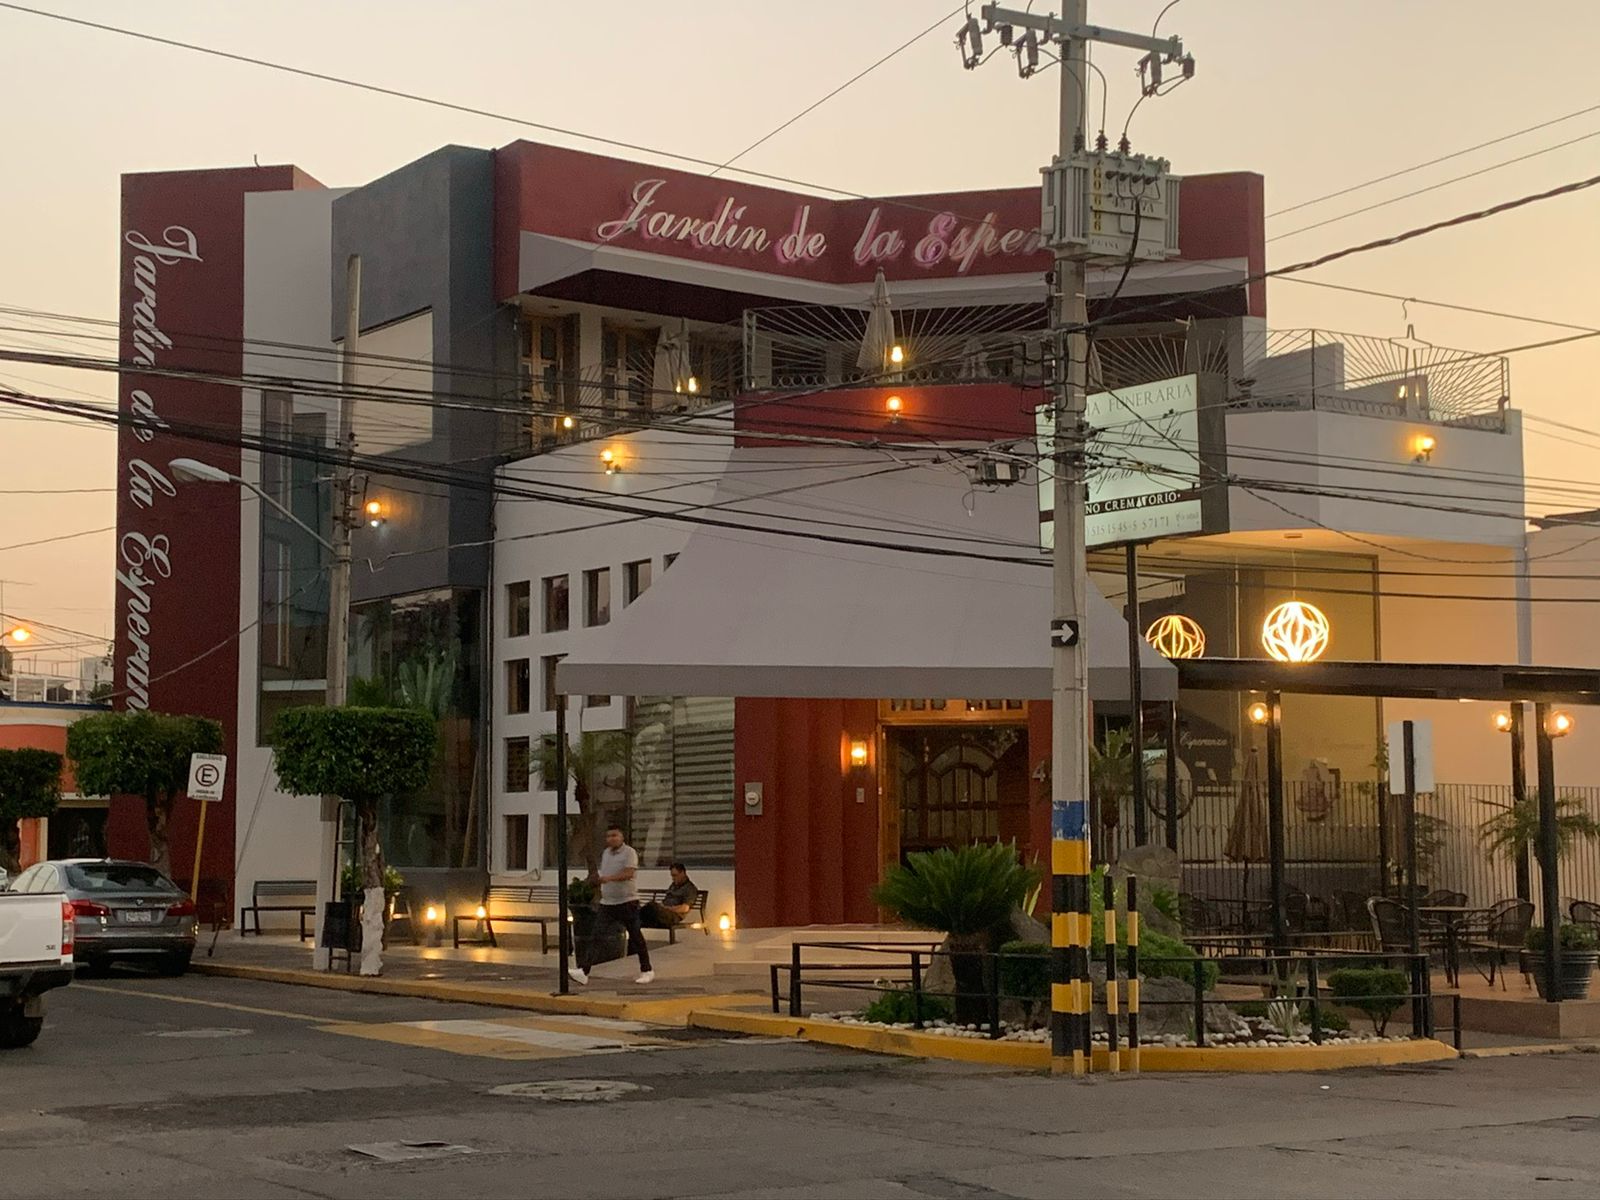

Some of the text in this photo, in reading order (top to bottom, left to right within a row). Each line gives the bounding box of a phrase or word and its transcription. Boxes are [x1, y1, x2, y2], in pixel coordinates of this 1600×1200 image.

[780, 204, 827, 261] de
[853, 207, 903, 262] la
[914, 210, 1042, 274] Esper
[1108, 383, 1193, 412] FUNERARIA
[128, 458, 177, 509] la
[117, 531, 171, 713] Esperan
[201, 768, 213, 784] E
